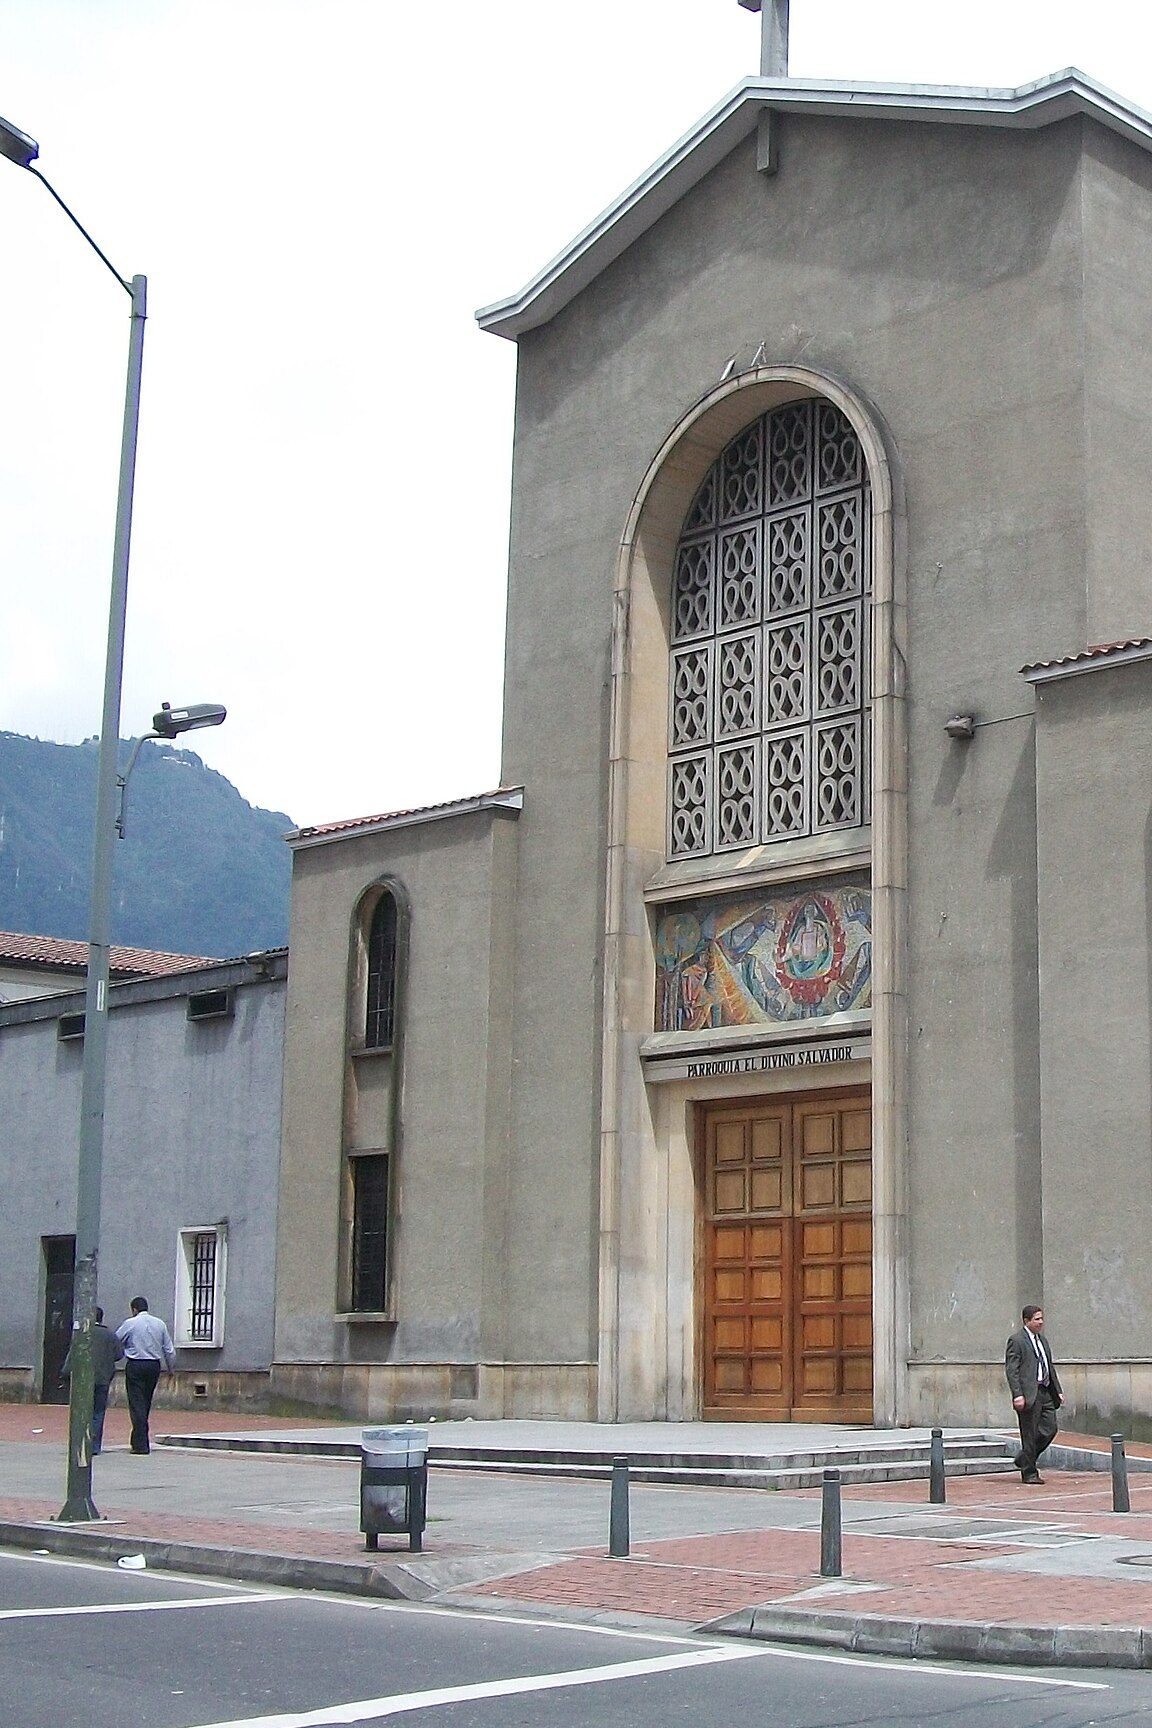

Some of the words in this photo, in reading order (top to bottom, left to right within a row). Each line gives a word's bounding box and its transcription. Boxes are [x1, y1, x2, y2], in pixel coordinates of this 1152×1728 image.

[688, 1060, 740, 1077] PARROQUIA
[745, 1058, 758, 1072] EL
[762, 1053, 795, 1069] DIVINO
[798, 1047, 852, 1064] SALVADOR
